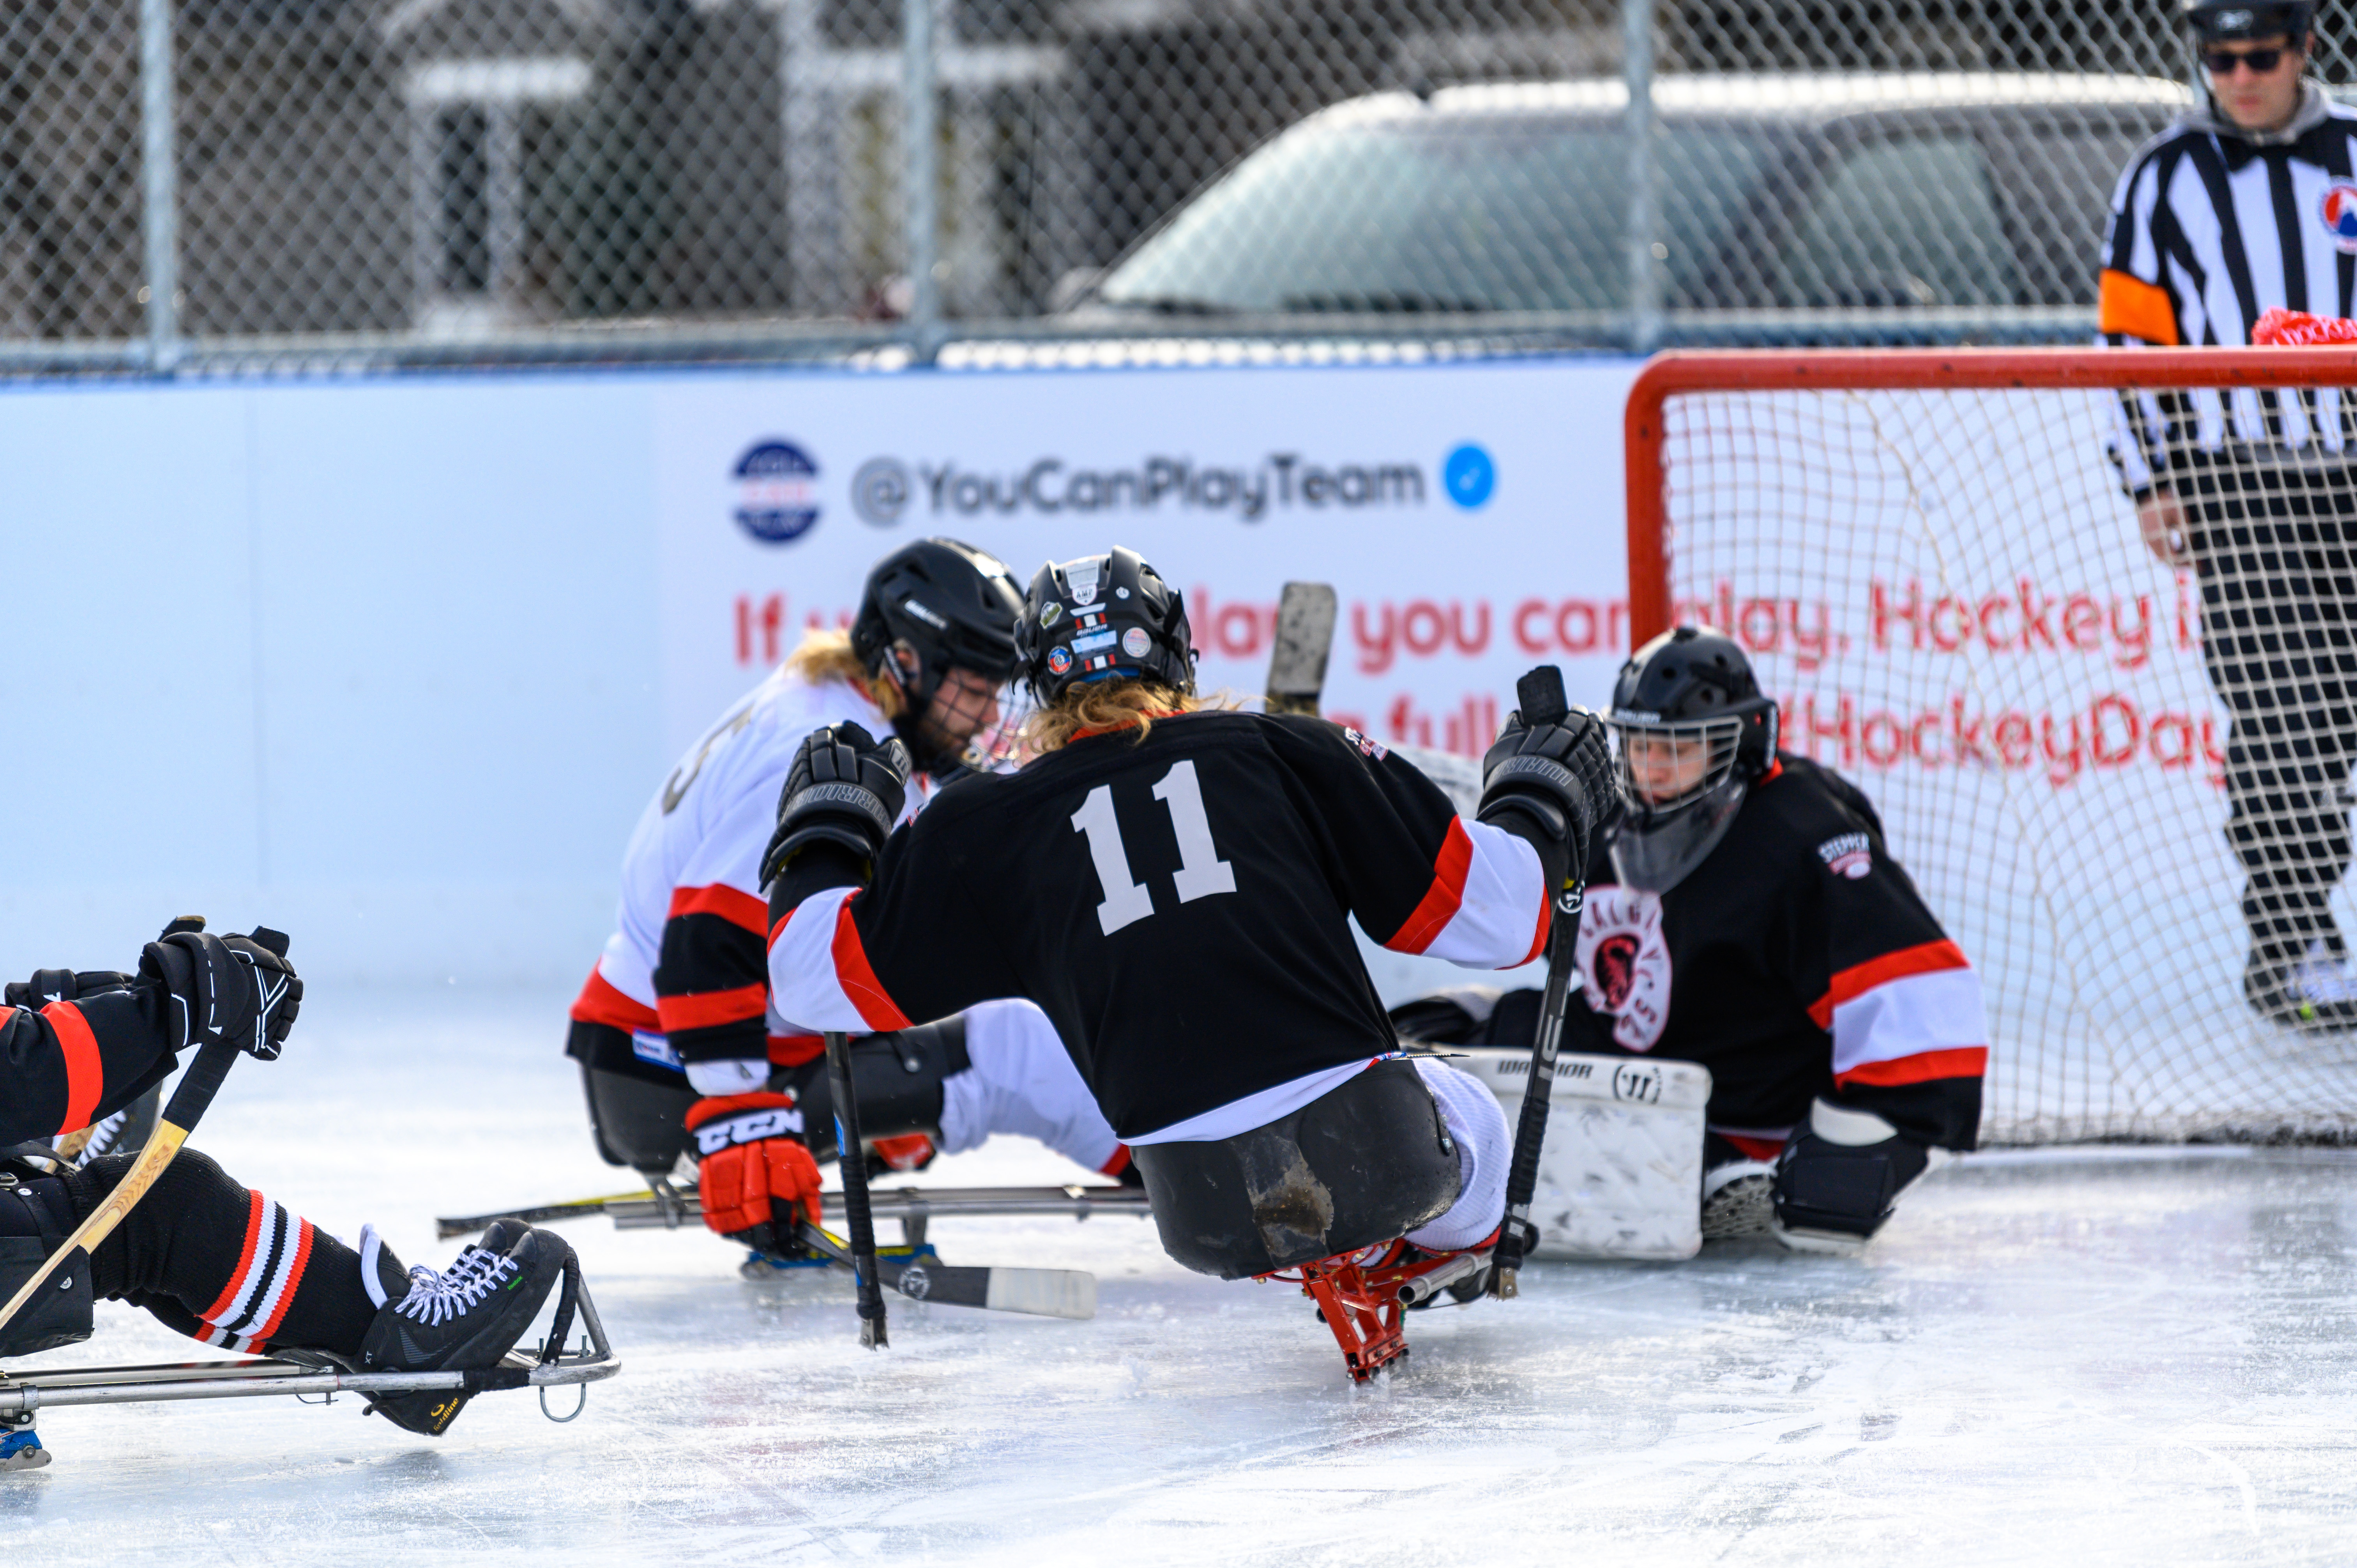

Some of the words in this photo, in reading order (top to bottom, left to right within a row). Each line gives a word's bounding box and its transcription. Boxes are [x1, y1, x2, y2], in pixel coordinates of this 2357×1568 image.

[851, 453, 1424, 527] @YouCanPlayTeam
[733, 592, 784, 665] If
[1352, 598, 1492, 677] you
[1873, 576, 2151, 670] Hockey
[1070, 759, 1237, 936] 11
[1497, 1059, 1594, 1079] WAIOR
[693, 1108, 804, 1155] CCM
[507, 1275, 523, 1290] Reebok
[364, 1351, 373, 1364] XT
